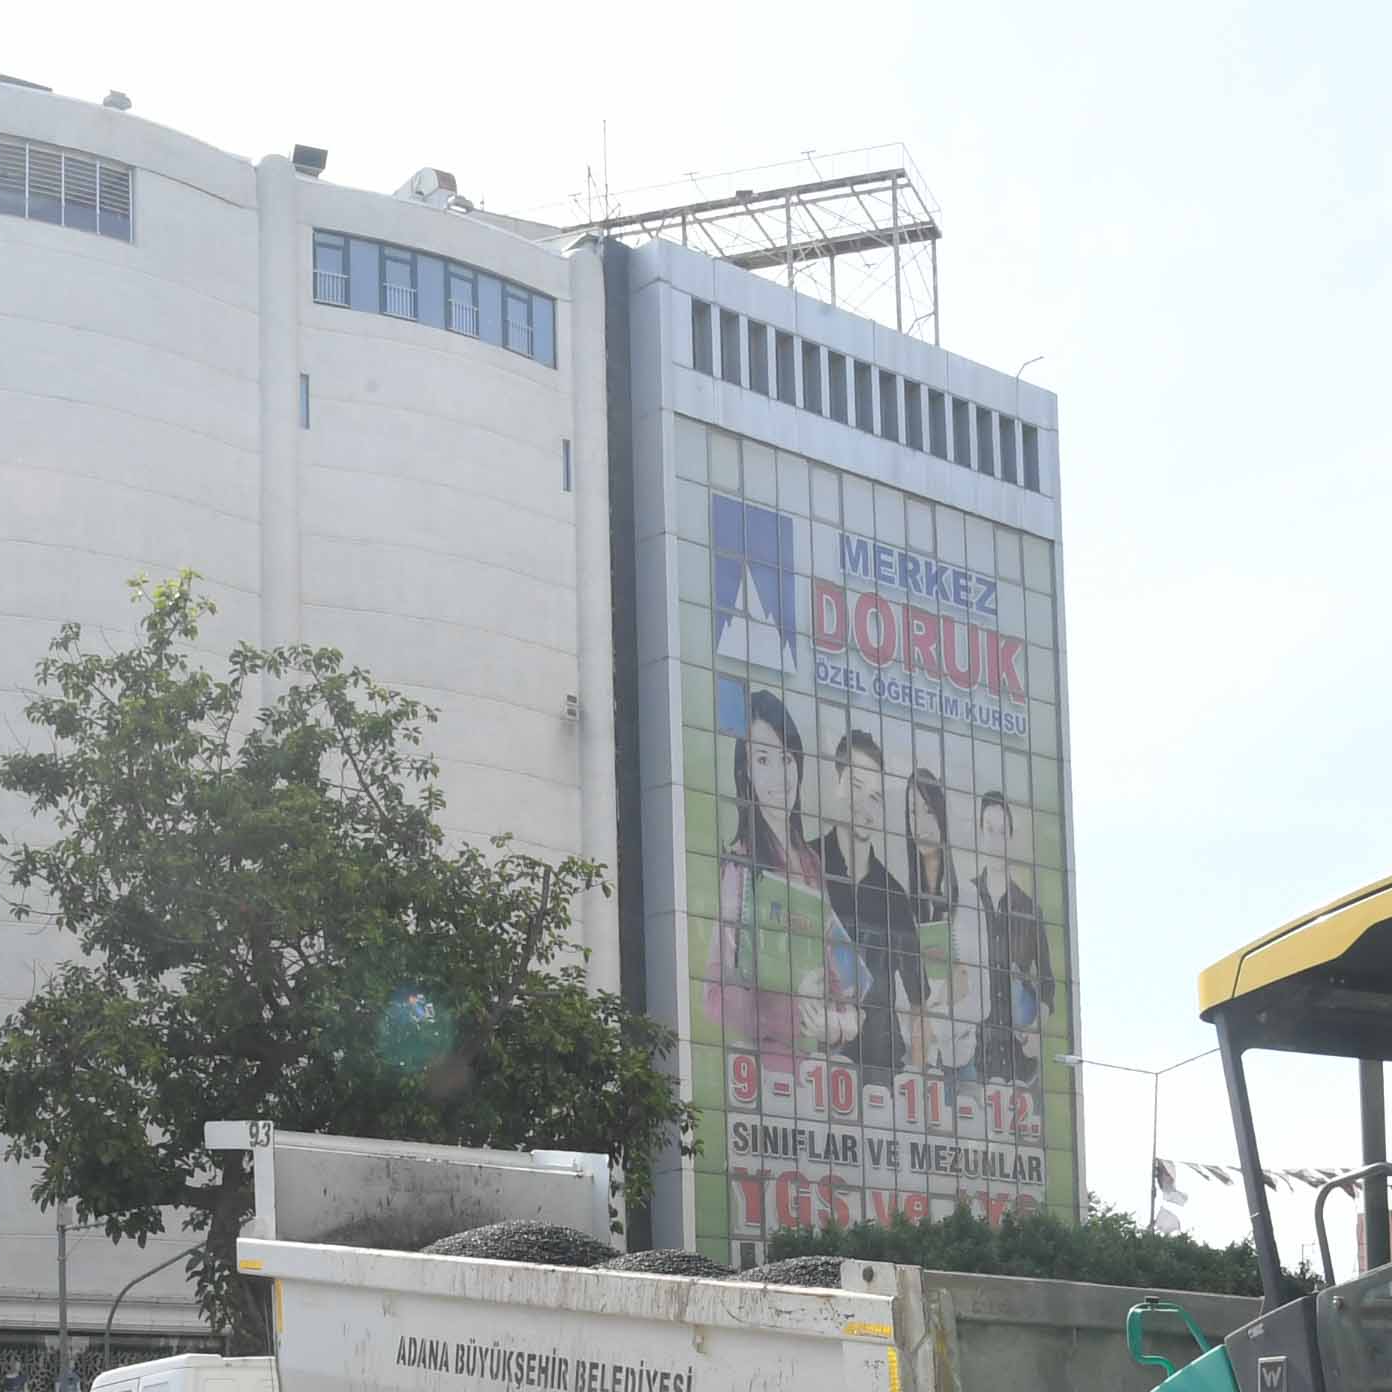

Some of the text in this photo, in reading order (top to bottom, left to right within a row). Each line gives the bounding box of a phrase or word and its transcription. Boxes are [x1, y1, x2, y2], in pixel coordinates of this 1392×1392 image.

[839, 533, 998, 616] MERKEZ
[812, 580, 1026, 705] DORUK
[815, 657, 1027, 735] ÖZEL ÖĞRETİM KURSU
[732, 1055, 757, 1101] 9
[808, 1063, 856, 1115] 10
[899, 1078, 942, 1125] 11
[732, 1121, 1044, 1186] SINIFLAR VE MEZUNLAR
[733, 1166, 852, 1230] YGS
[396, 1336, 450, 1373] ADANA
[455, 1338, 568, 1390] BÜYÜKŞEHİR
